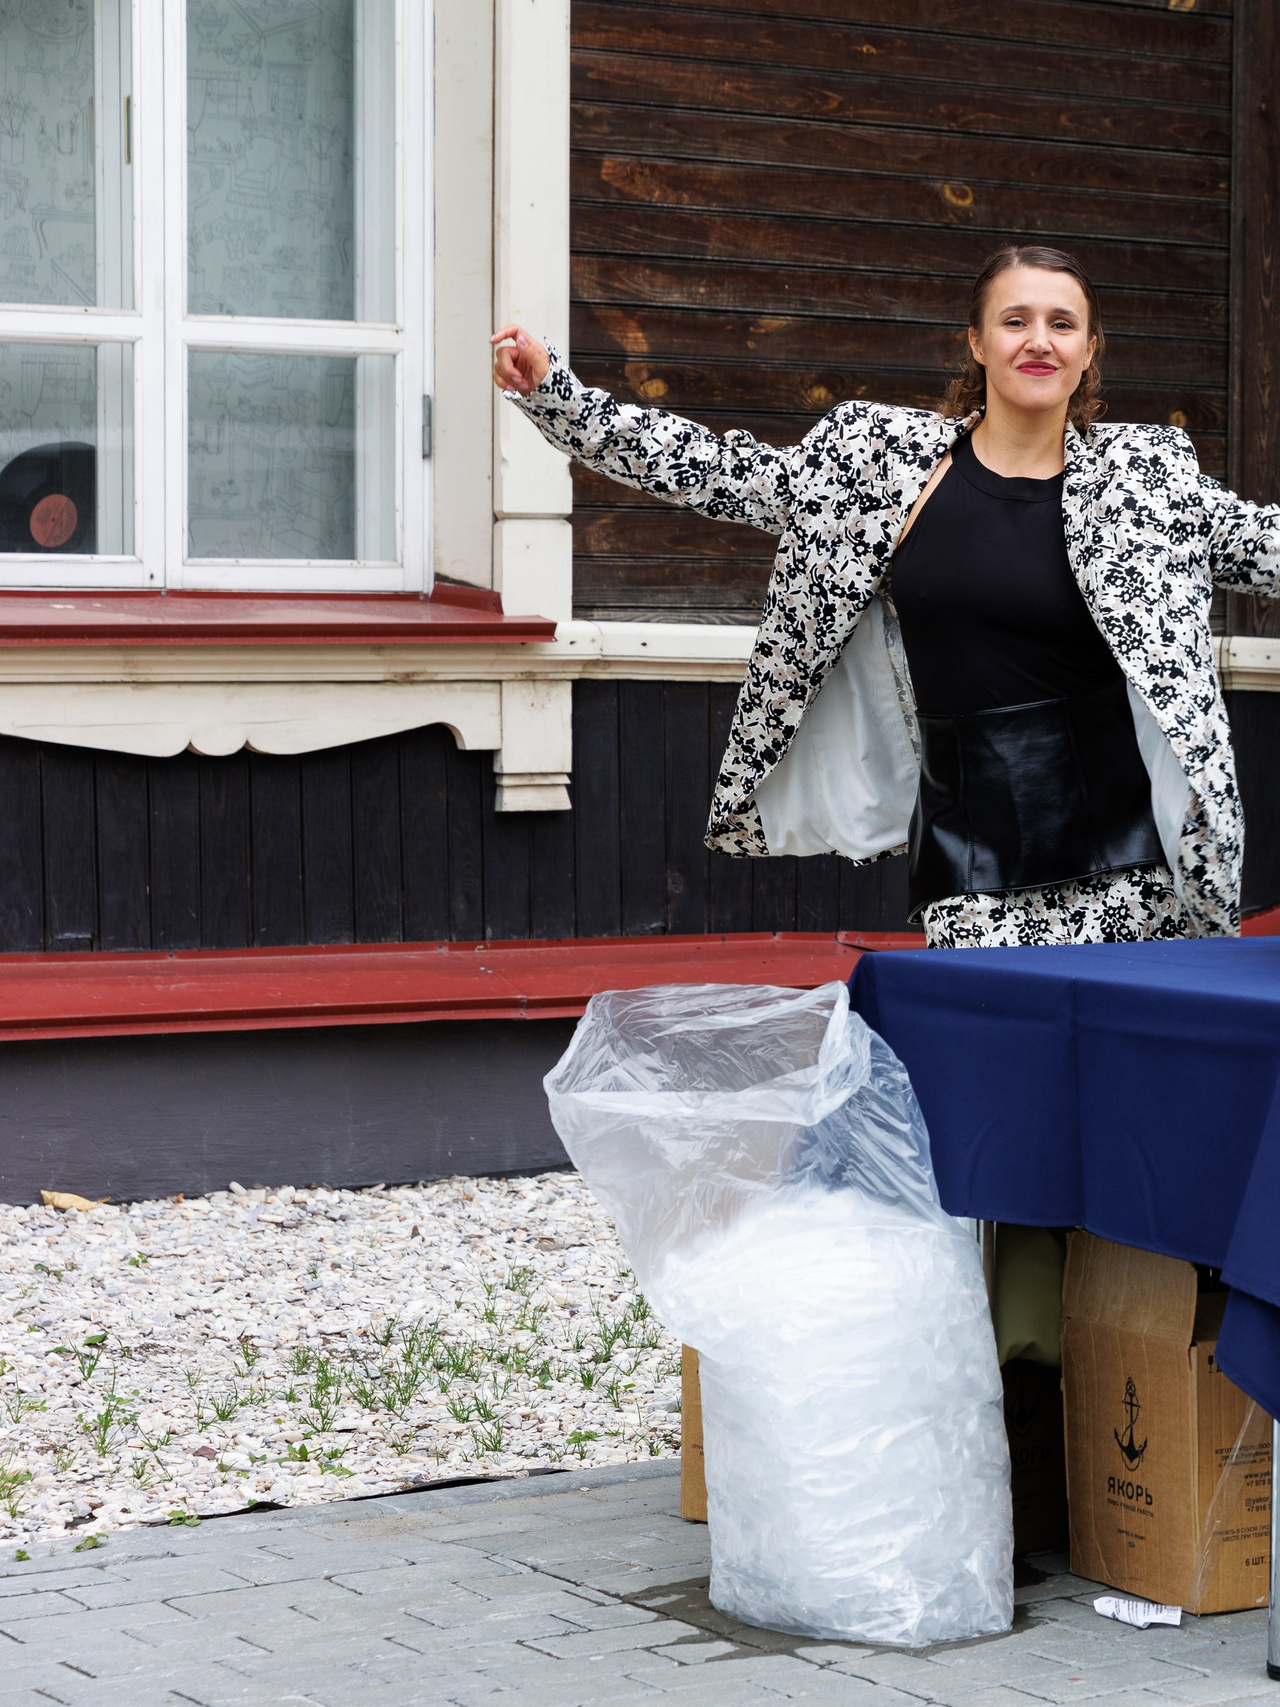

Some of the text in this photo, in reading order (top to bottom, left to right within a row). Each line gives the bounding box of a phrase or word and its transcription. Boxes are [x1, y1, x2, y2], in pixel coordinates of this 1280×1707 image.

[1010, 1443, 1051, 1467] КОРЬ
[1107, 1476, 1153, 1506] ЯКОРЬ
[1245, 1556, 1267, 1567] 6 ШТ.
